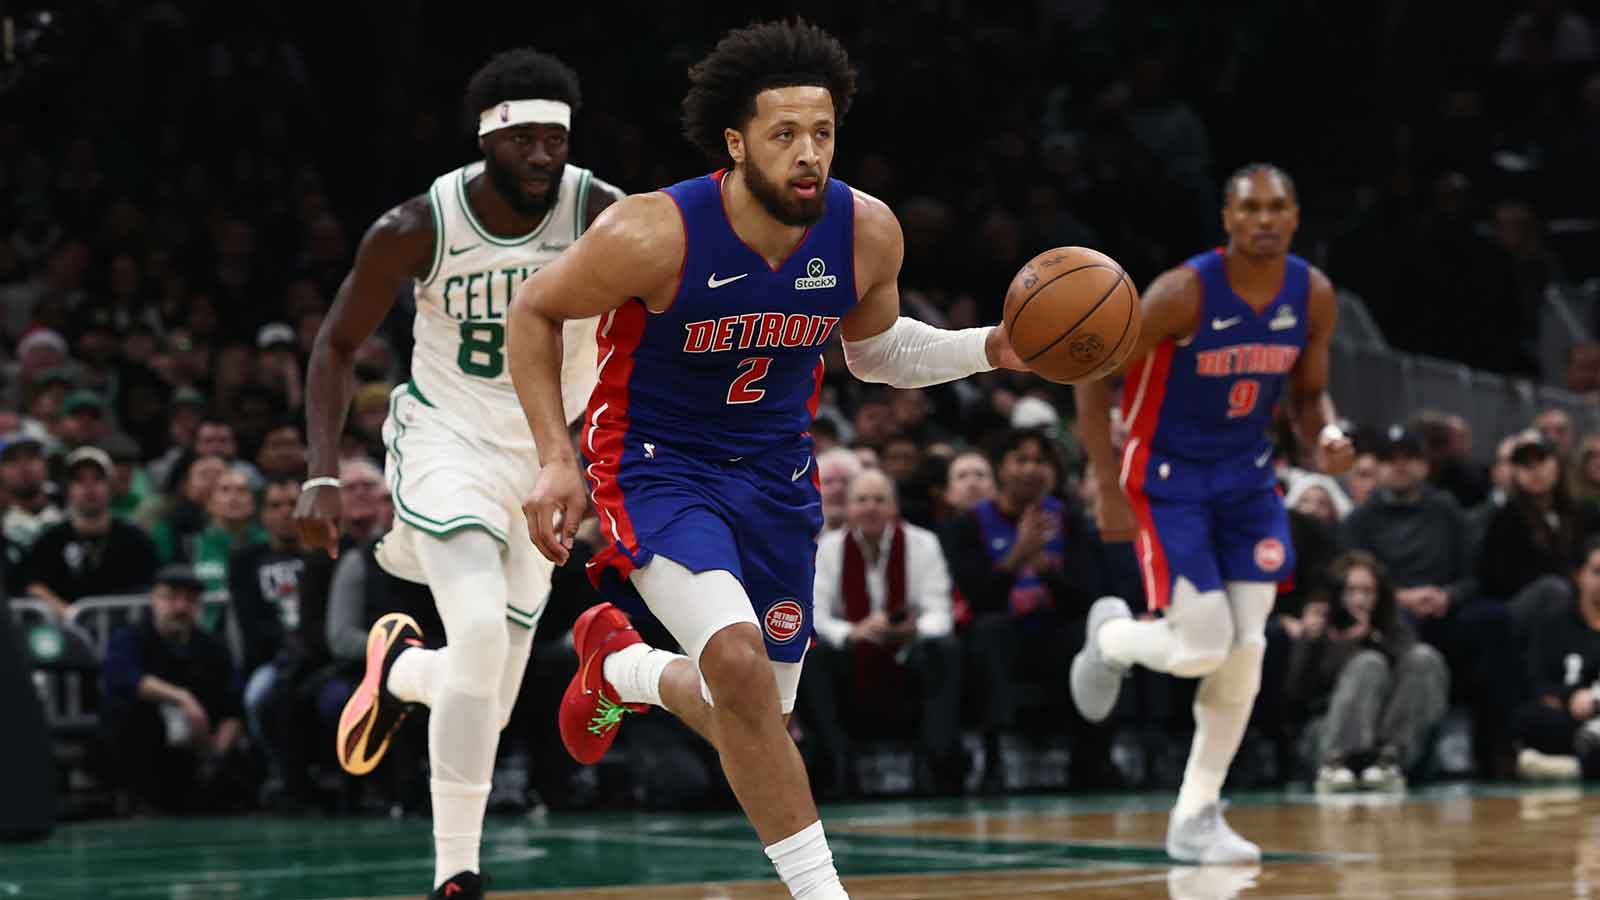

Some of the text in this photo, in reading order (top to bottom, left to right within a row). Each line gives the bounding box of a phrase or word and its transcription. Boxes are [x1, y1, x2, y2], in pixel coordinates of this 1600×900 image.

[443, 266, 542, 320] CELT
[796, 277, 835, 289] StockX
[457, 321, 505, 379] 8
[683, 312, 841, 353] DETROIT
[726, 356, 774, 405] 2
[1226, 379, 1261, 419] 9
